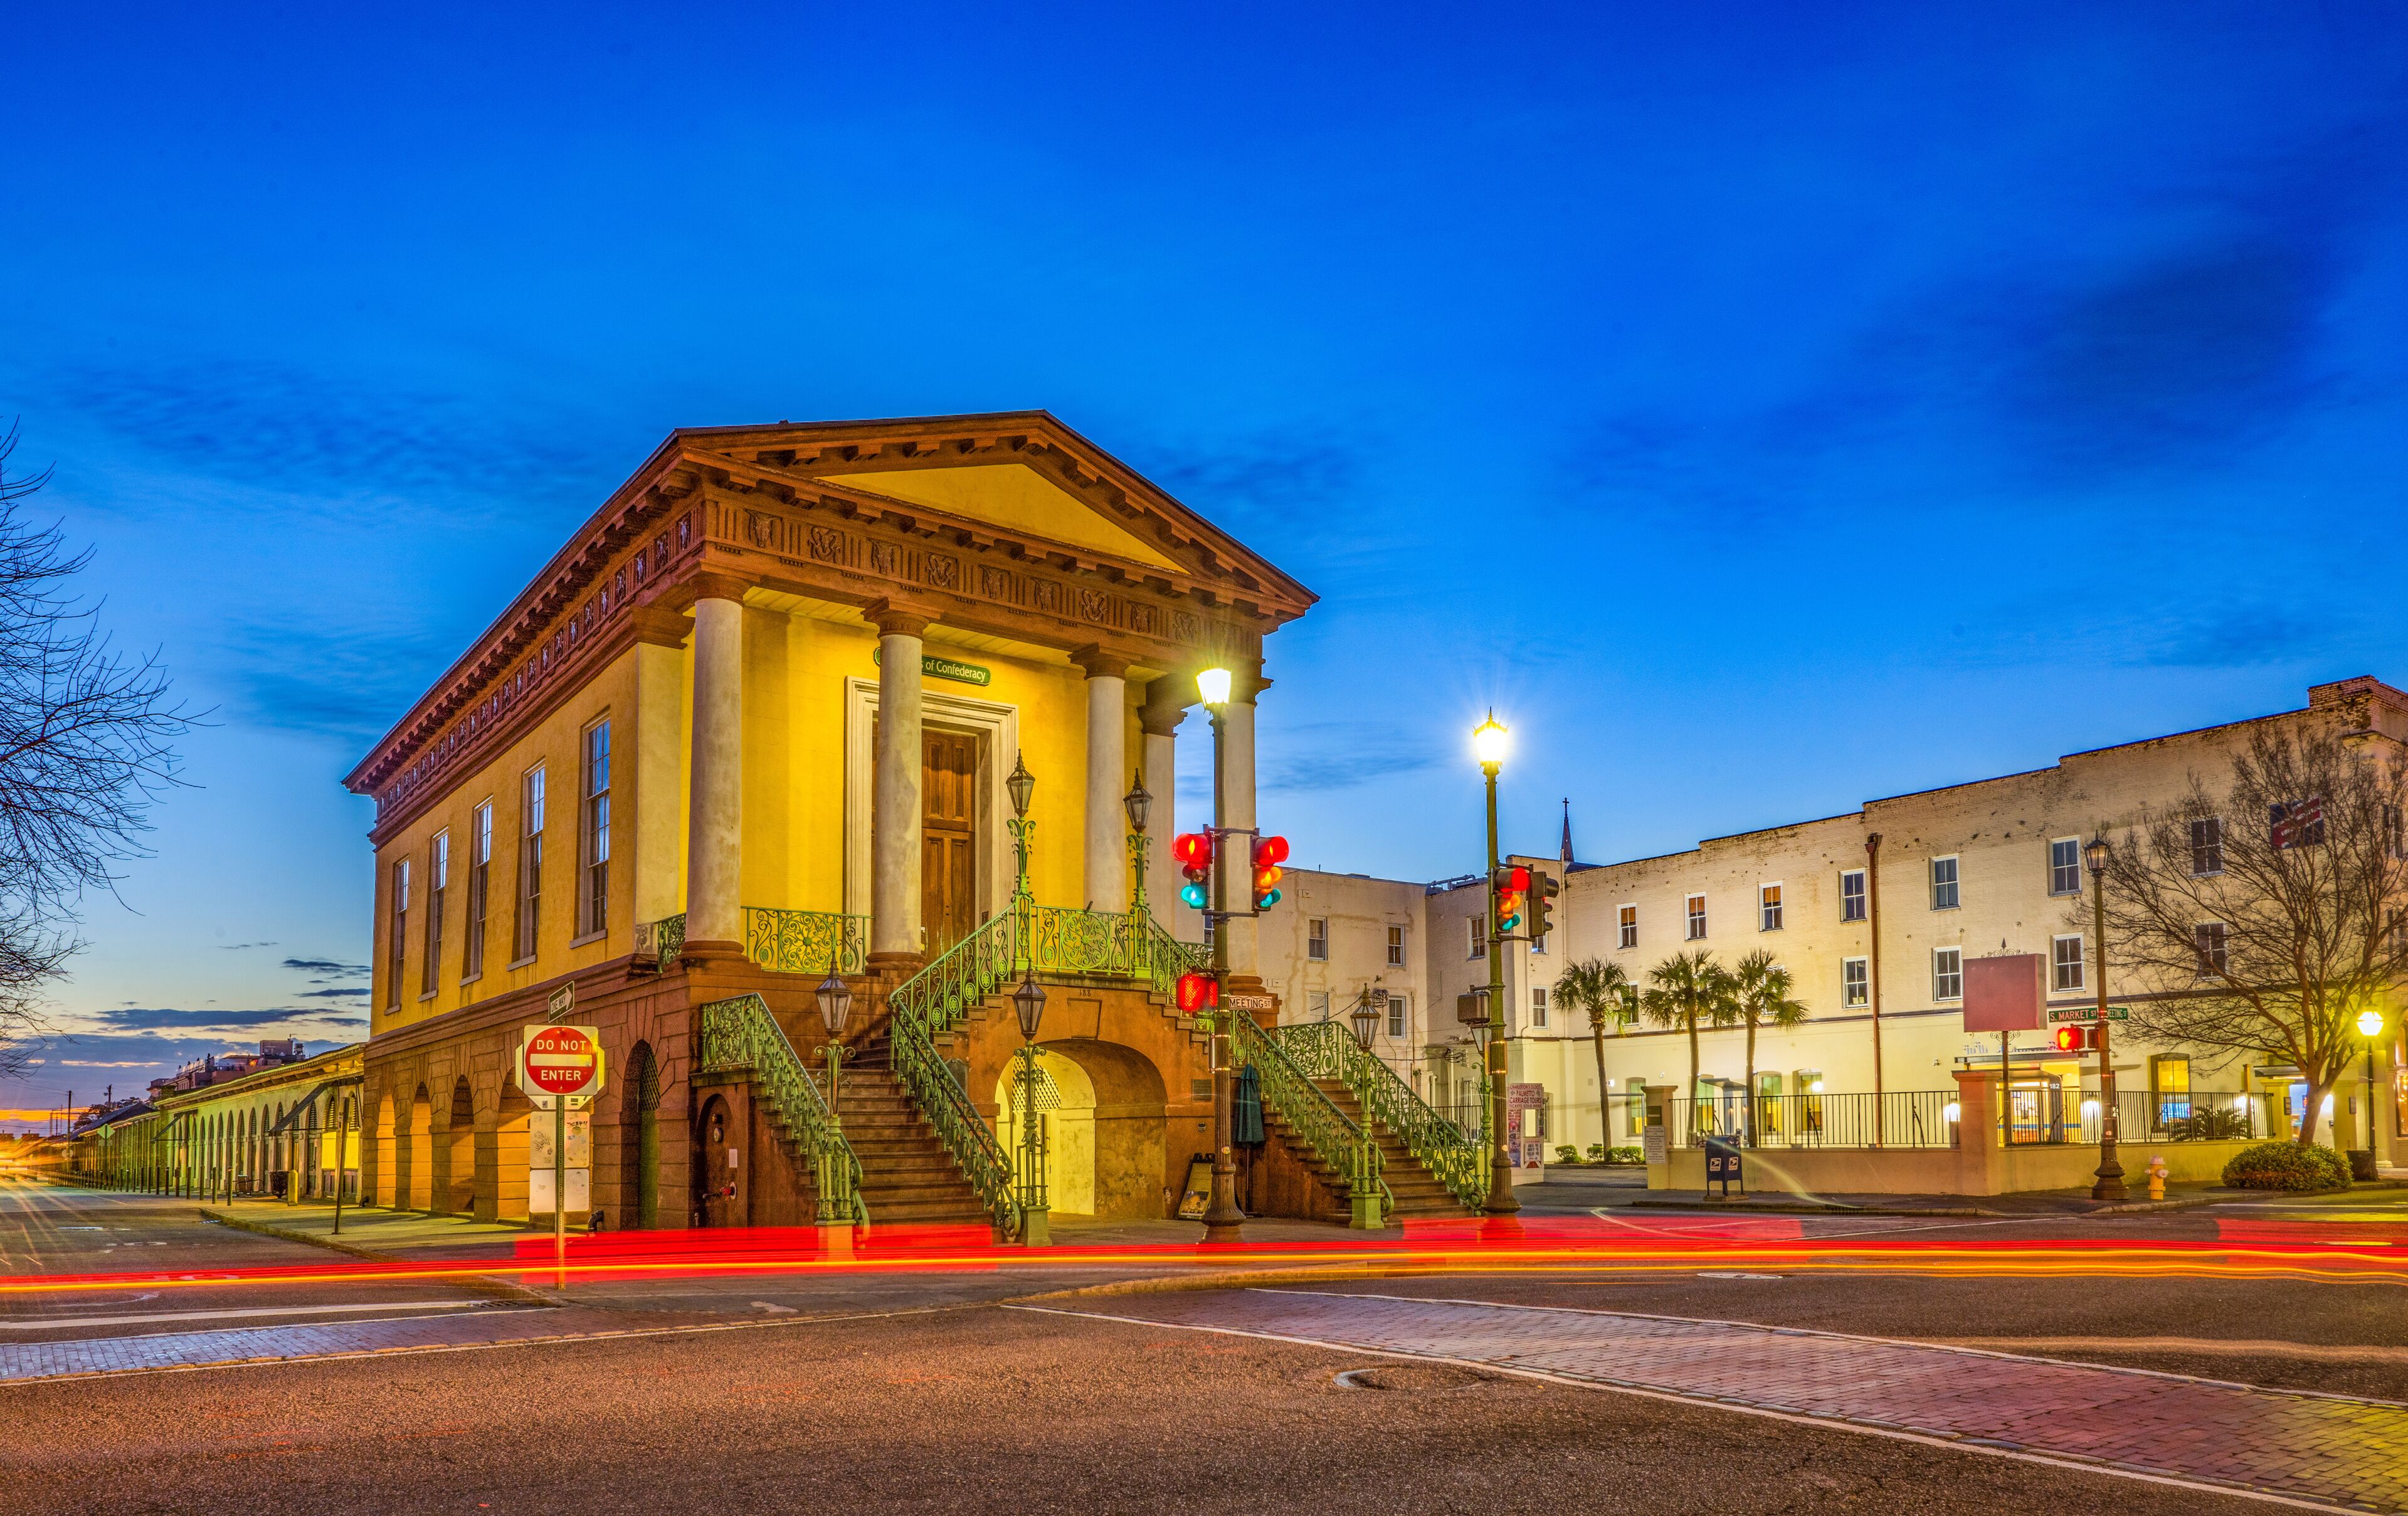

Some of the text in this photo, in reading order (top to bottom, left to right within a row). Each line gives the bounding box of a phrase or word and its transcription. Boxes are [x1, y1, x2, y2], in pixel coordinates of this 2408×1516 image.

[926, 660, 934, 670] of
[936, 661, 986, 683] Confederacy
[1229, 999, 1263, 1008] MEETING
[2050, 1013, 2056, 1021] S.
[2058, 1009, 2089, 1020] MARKET
[537, 1040, 586, 1050] DO NOT
[541, 1070, 581, 1081] ENTER
